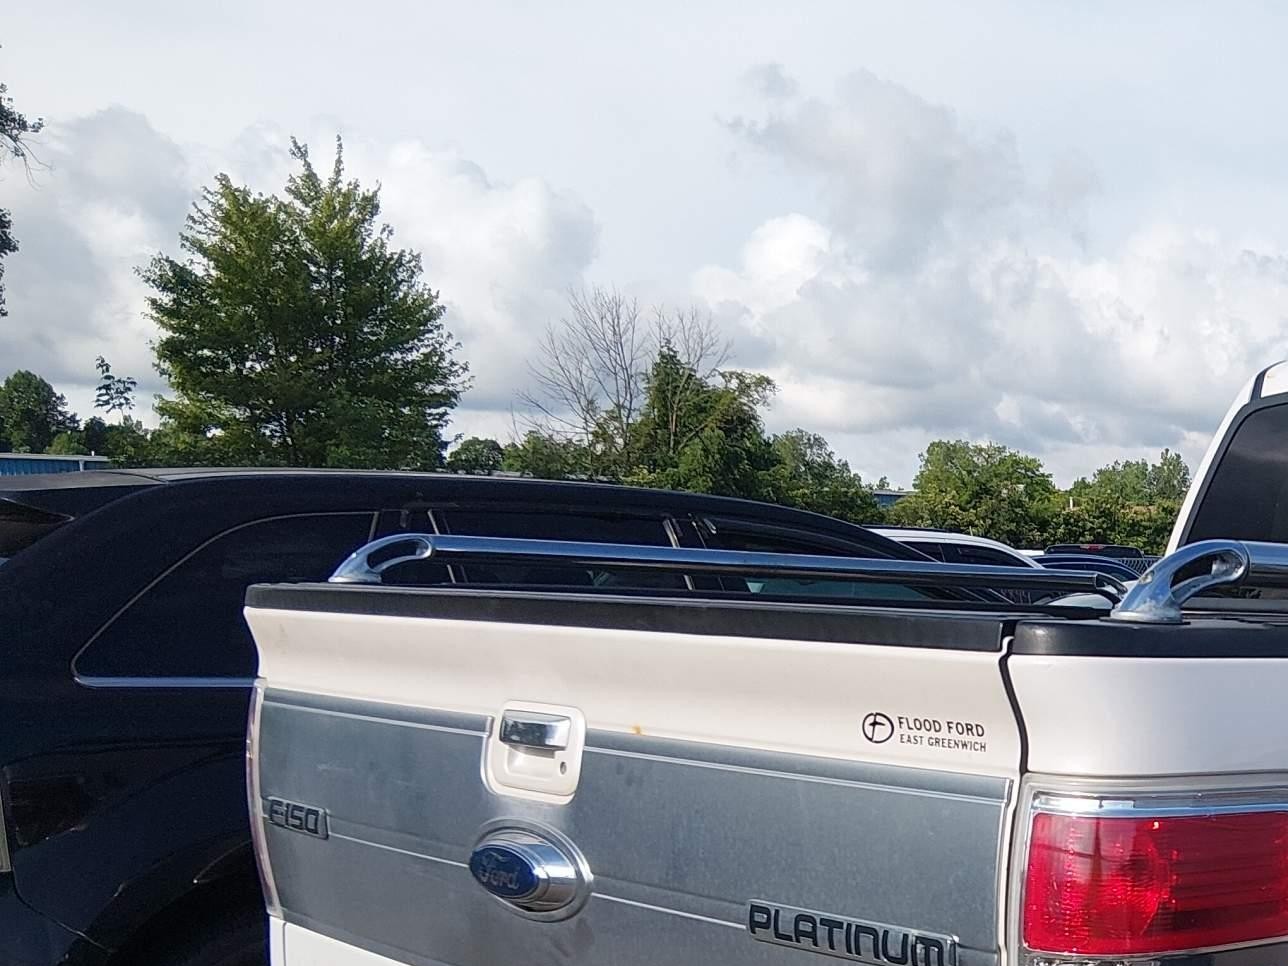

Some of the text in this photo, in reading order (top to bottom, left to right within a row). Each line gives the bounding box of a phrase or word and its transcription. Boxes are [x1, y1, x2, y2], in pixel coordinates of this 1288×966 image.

[898, 716, 985, 737] FLOOD FORD
[900, 734, 987, 752] EAST GREENWICH
[479, 851, 519, 890] Ford
